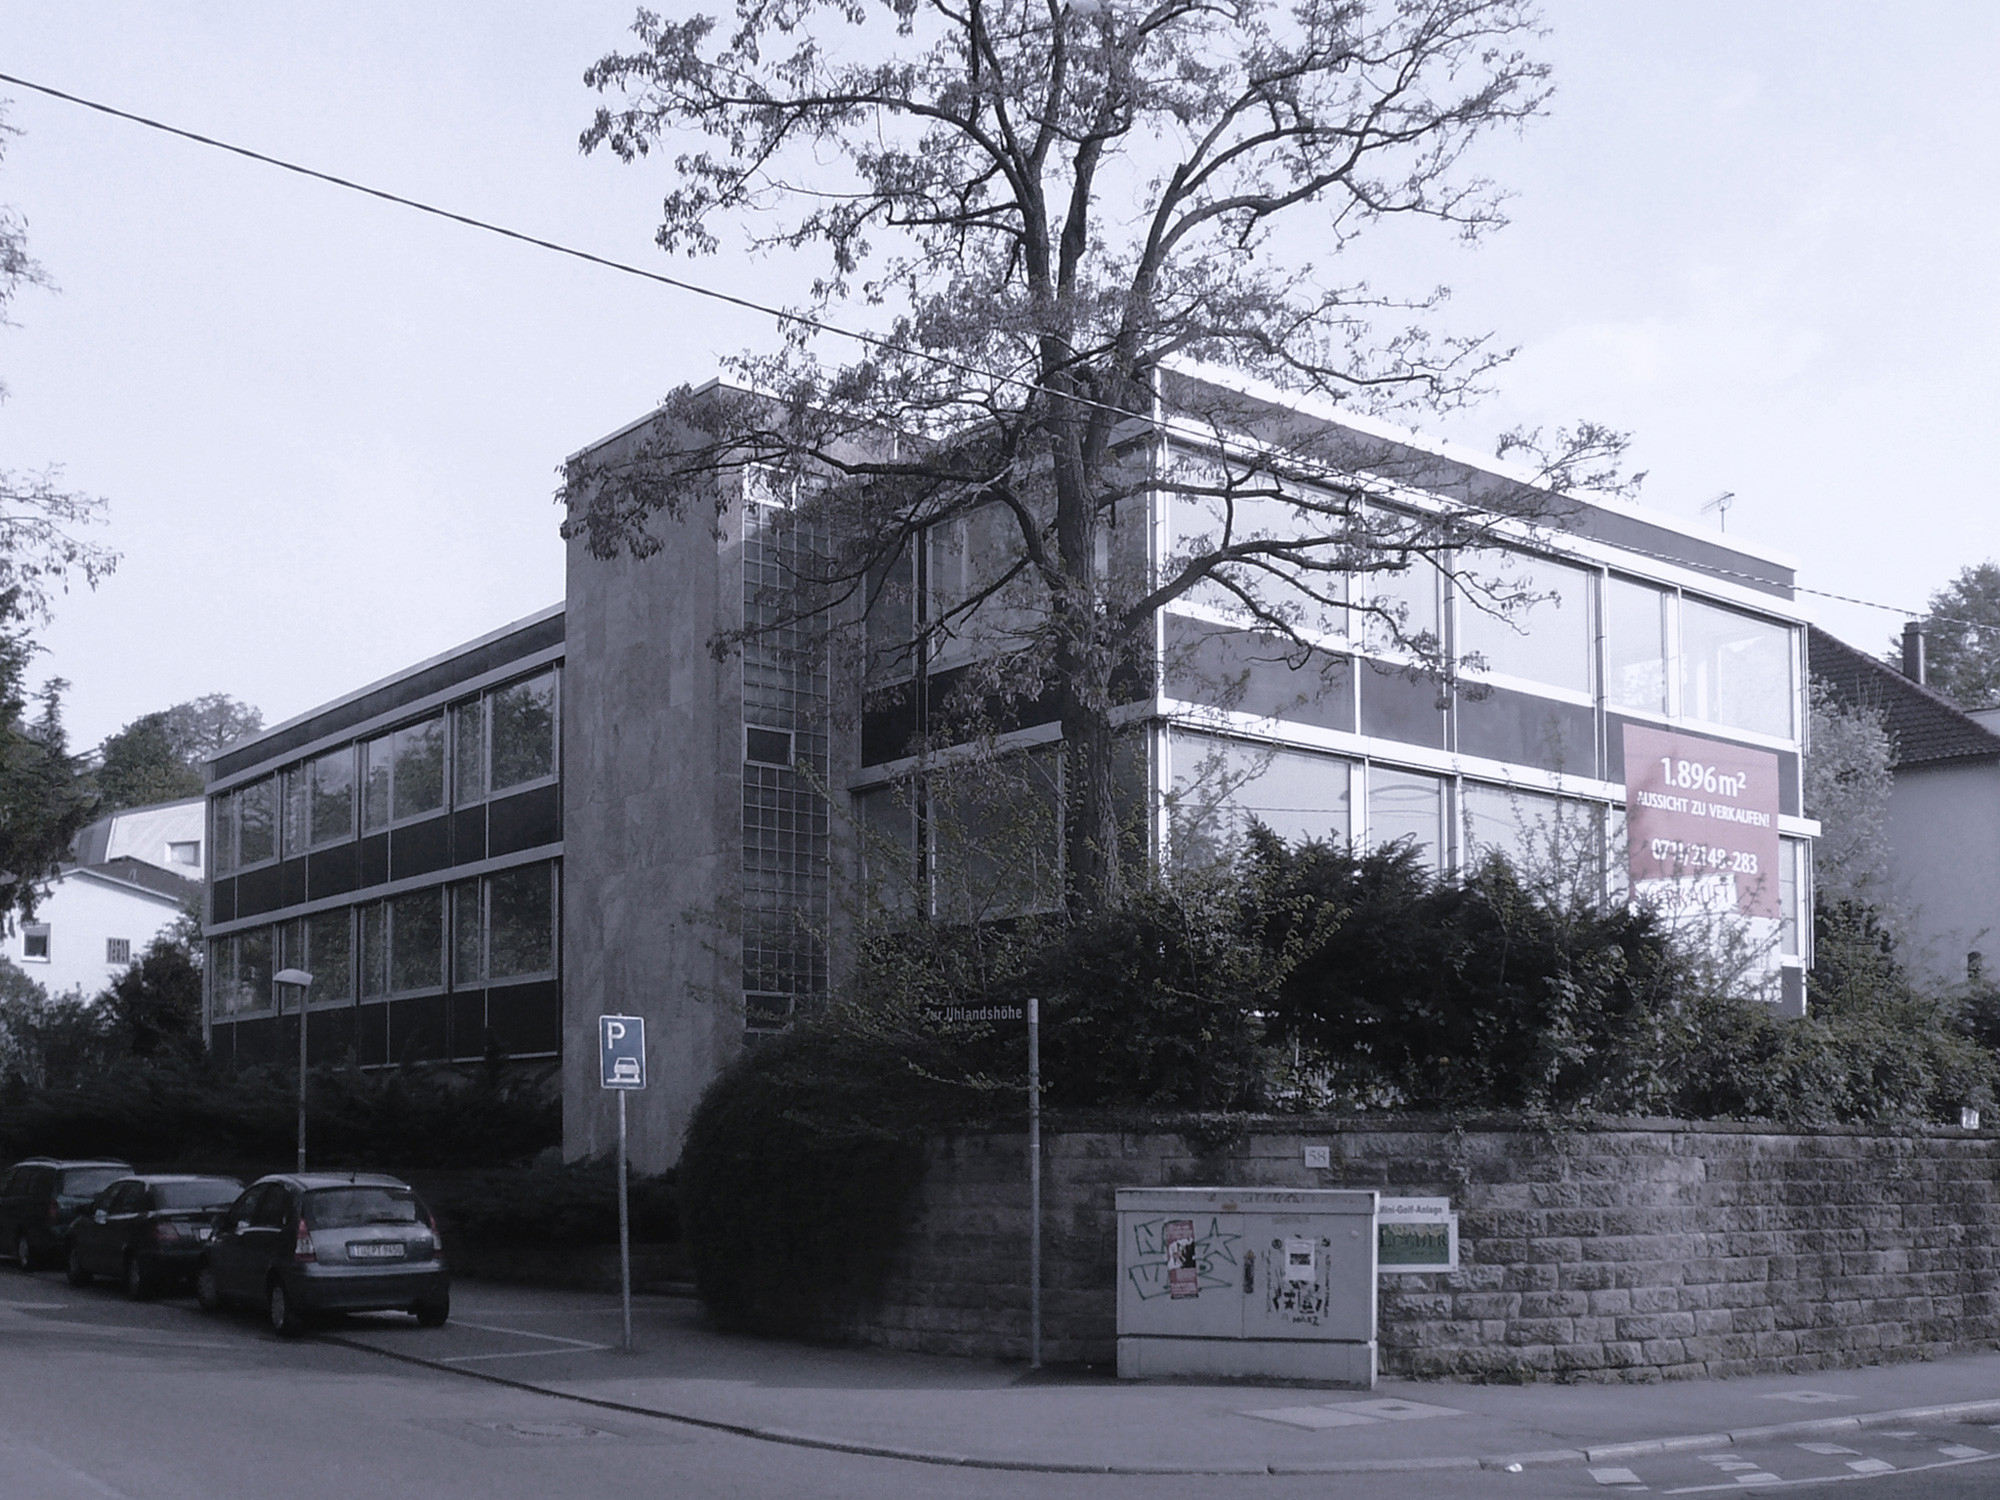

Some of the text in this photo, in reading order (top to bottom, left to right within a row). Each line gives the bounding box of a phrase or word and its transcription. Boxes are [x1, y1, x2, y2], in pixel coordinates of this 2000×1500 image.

[1637, 791, 1770, 828] AUSSICHT ZU VERKAUFEN!
[944, 1005, 1022, 1020] Uhlandshöhe
[608, 1022, 626, 1049] P
